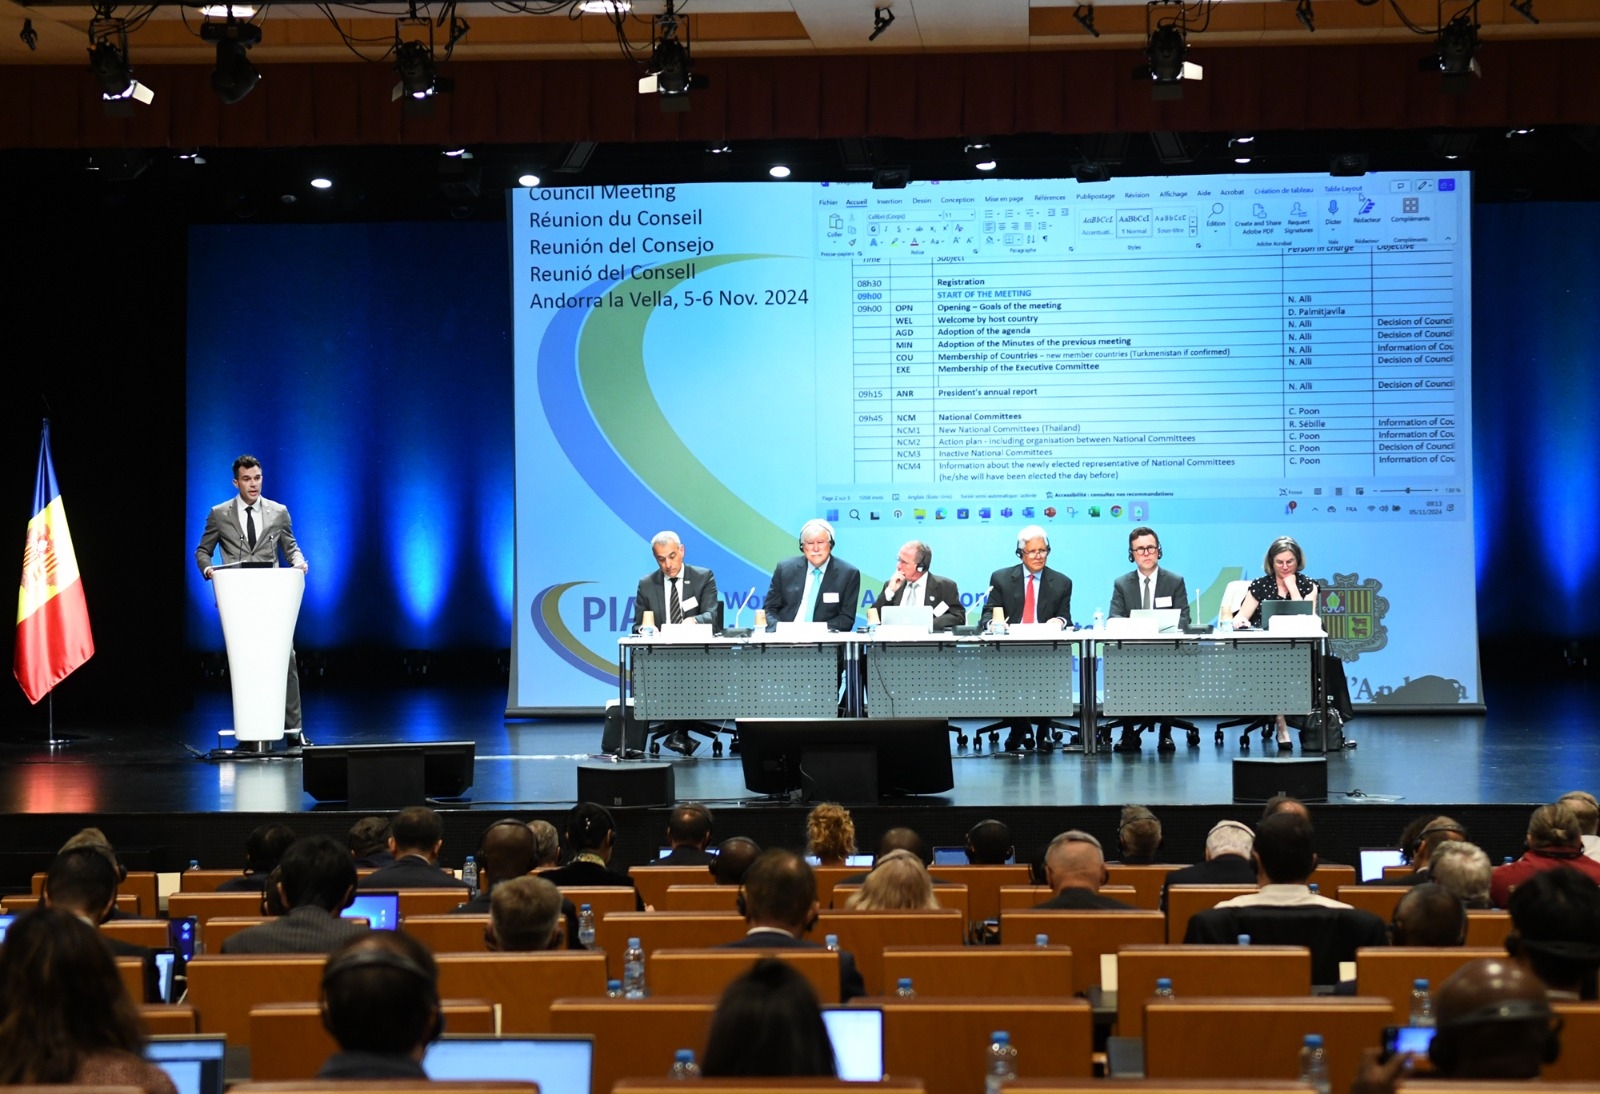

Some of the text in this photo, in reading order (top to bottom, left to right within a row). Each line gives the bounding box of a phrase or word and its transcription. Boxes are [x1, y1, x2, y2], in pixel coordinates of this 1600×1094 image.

[529, 184, 676, 202] Council Meeting
[530, 209, 702, 228] Réunion du Conseil
[530, 236, 714, 256] Reunión del Consejo
[530, 263, 696, 281] Reunió del Consell
[857, 280, 882, 288] 08h30
[937, 278, 985, 287] Registration
[994, 290, 1032, 298] MEETING
[530, 289, 808, 310] Andorra la Vella, 5-6 Nov. 2024
[937, 304, 970, 312] Opening
[1029, 302, 1062, 310] meeting
[1299, 307, 1345, 317] Palmitjavila
[976, 316, 986, 324] by
[1007, 315, 1038, 324] country
[938, 328, 974, 336] Adoption
[1002, 327, 1030, 336] agenda
[1062, 338, 1096, 347] previous
[1098, 338, 1131, 346] meeting
[938, 353, 988, 361] Membership
[1130, 349, 1182, 359] (Turkmenistan
[1190, 348, 1230, 358] confirmed)
[938, 365, 988, 373] Membership
[1012, 388, 1037, 396] report
[1041, 424, 1081, 433] (Thailand)
[1299, 420, 1326, 428] Sébille
[966, 437, 982, 446] plan
[989, 437, 1024, 446] including
[1026, 436, 1075, 445] organisation
[1076, 435, 1111, 443] between
[1113, 434, 1146, 442] National
[1148, 434, 1196, 442] Committees
[1026, 461, 1050, 470] newly
[1082, 459, 1139, 468] representative
[1151, 459, 1185, 467] National
[1186, 458, 1235, 466] Committees
[939, 473, 969, 482] (he/she
[1073, 472, 1088, 480] day
[1089, 471, 1119, 480] before)
